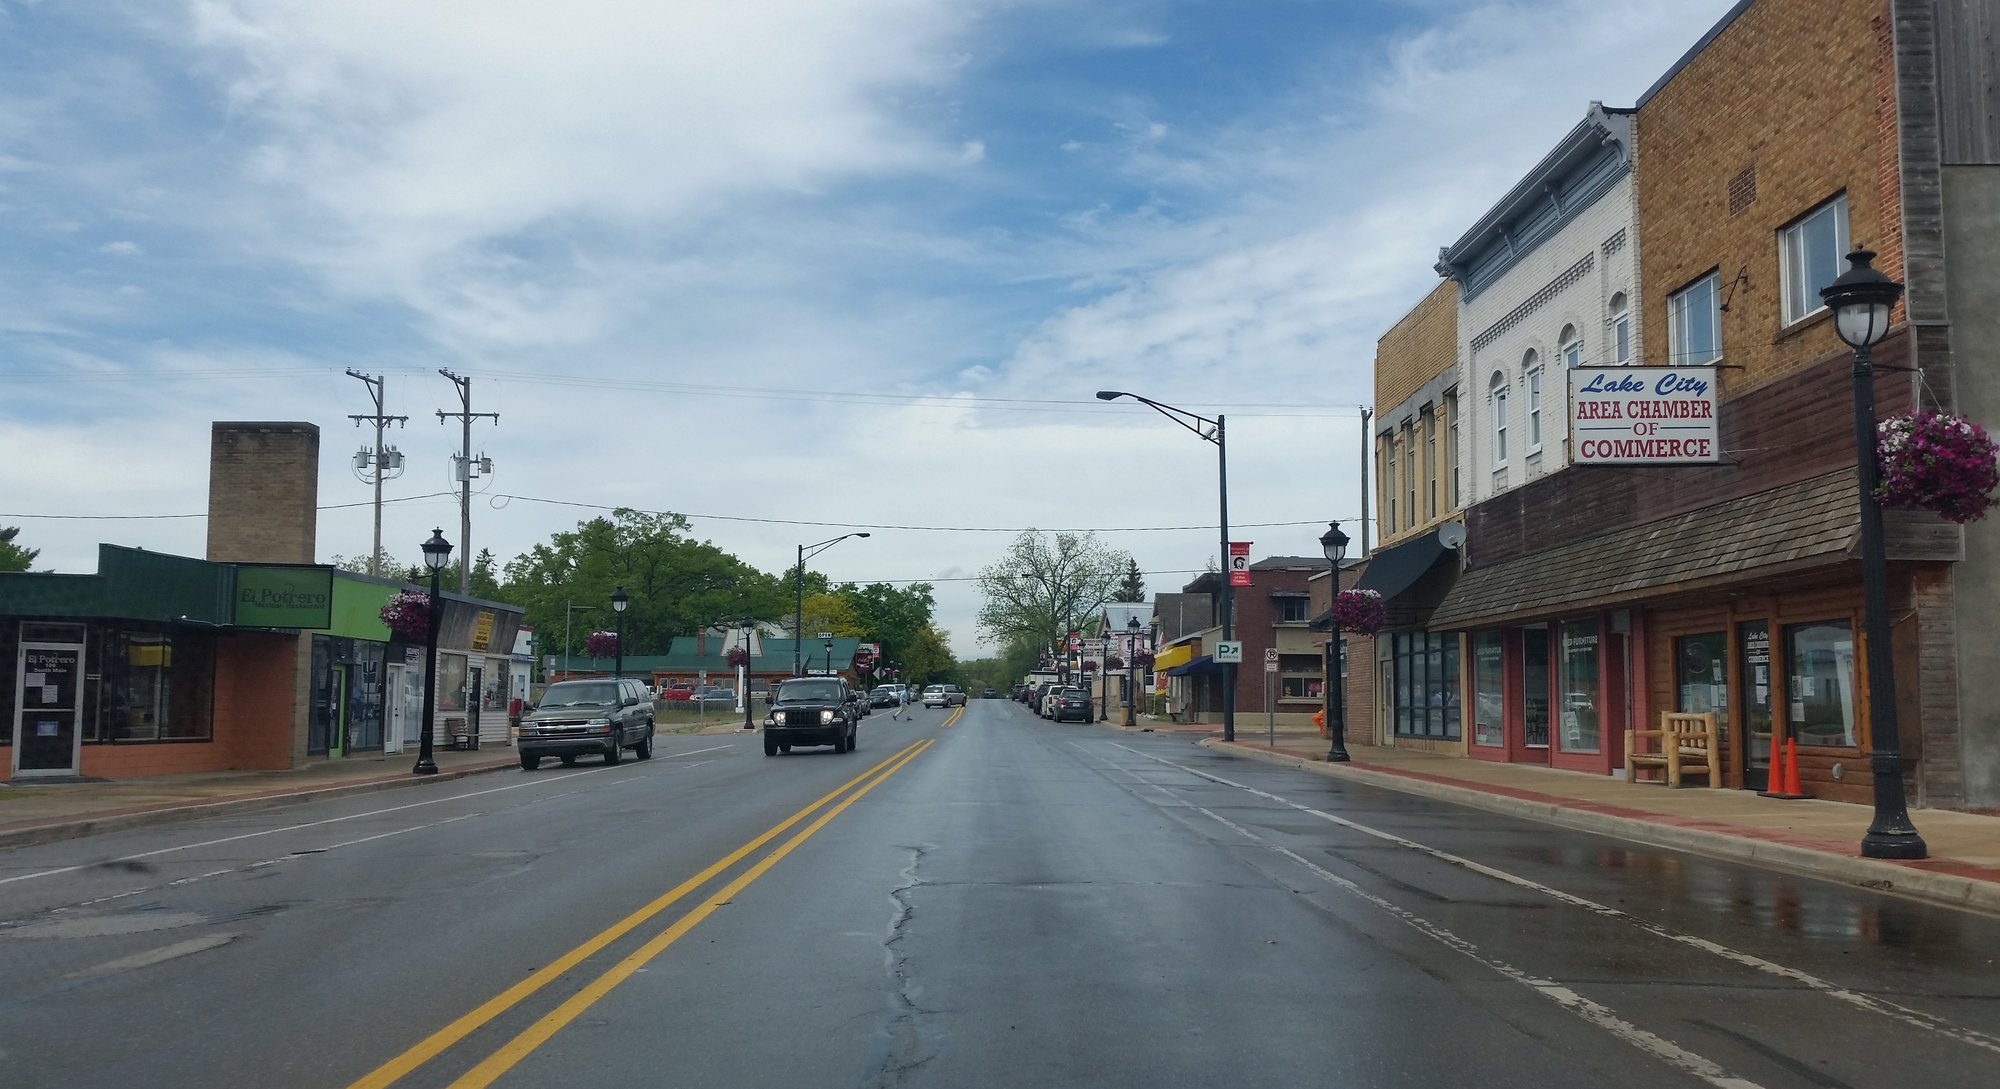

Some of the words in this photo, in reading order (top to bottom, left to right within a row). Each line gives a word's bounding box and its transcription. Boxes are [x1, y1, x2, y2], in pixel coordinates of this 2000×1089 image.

[1580, 374, 1645, 393] Lake
[1655, 373, 1708, 397] City
[1577, 401, 1622, 419] AREA
[1627, 400, 1712, 419] CHAMBER
[1633, 422, 1659, 436] OF
[1581, 439, 1711, 458] COMMERCE
[241, 588, 256, 602] El
[261, 587, 326, 604] Potrero
[1573, 635, 1597, 646] FURNITURE
[28, 655, 37, 664] El
[39, 653, 75, 663] Potrero
